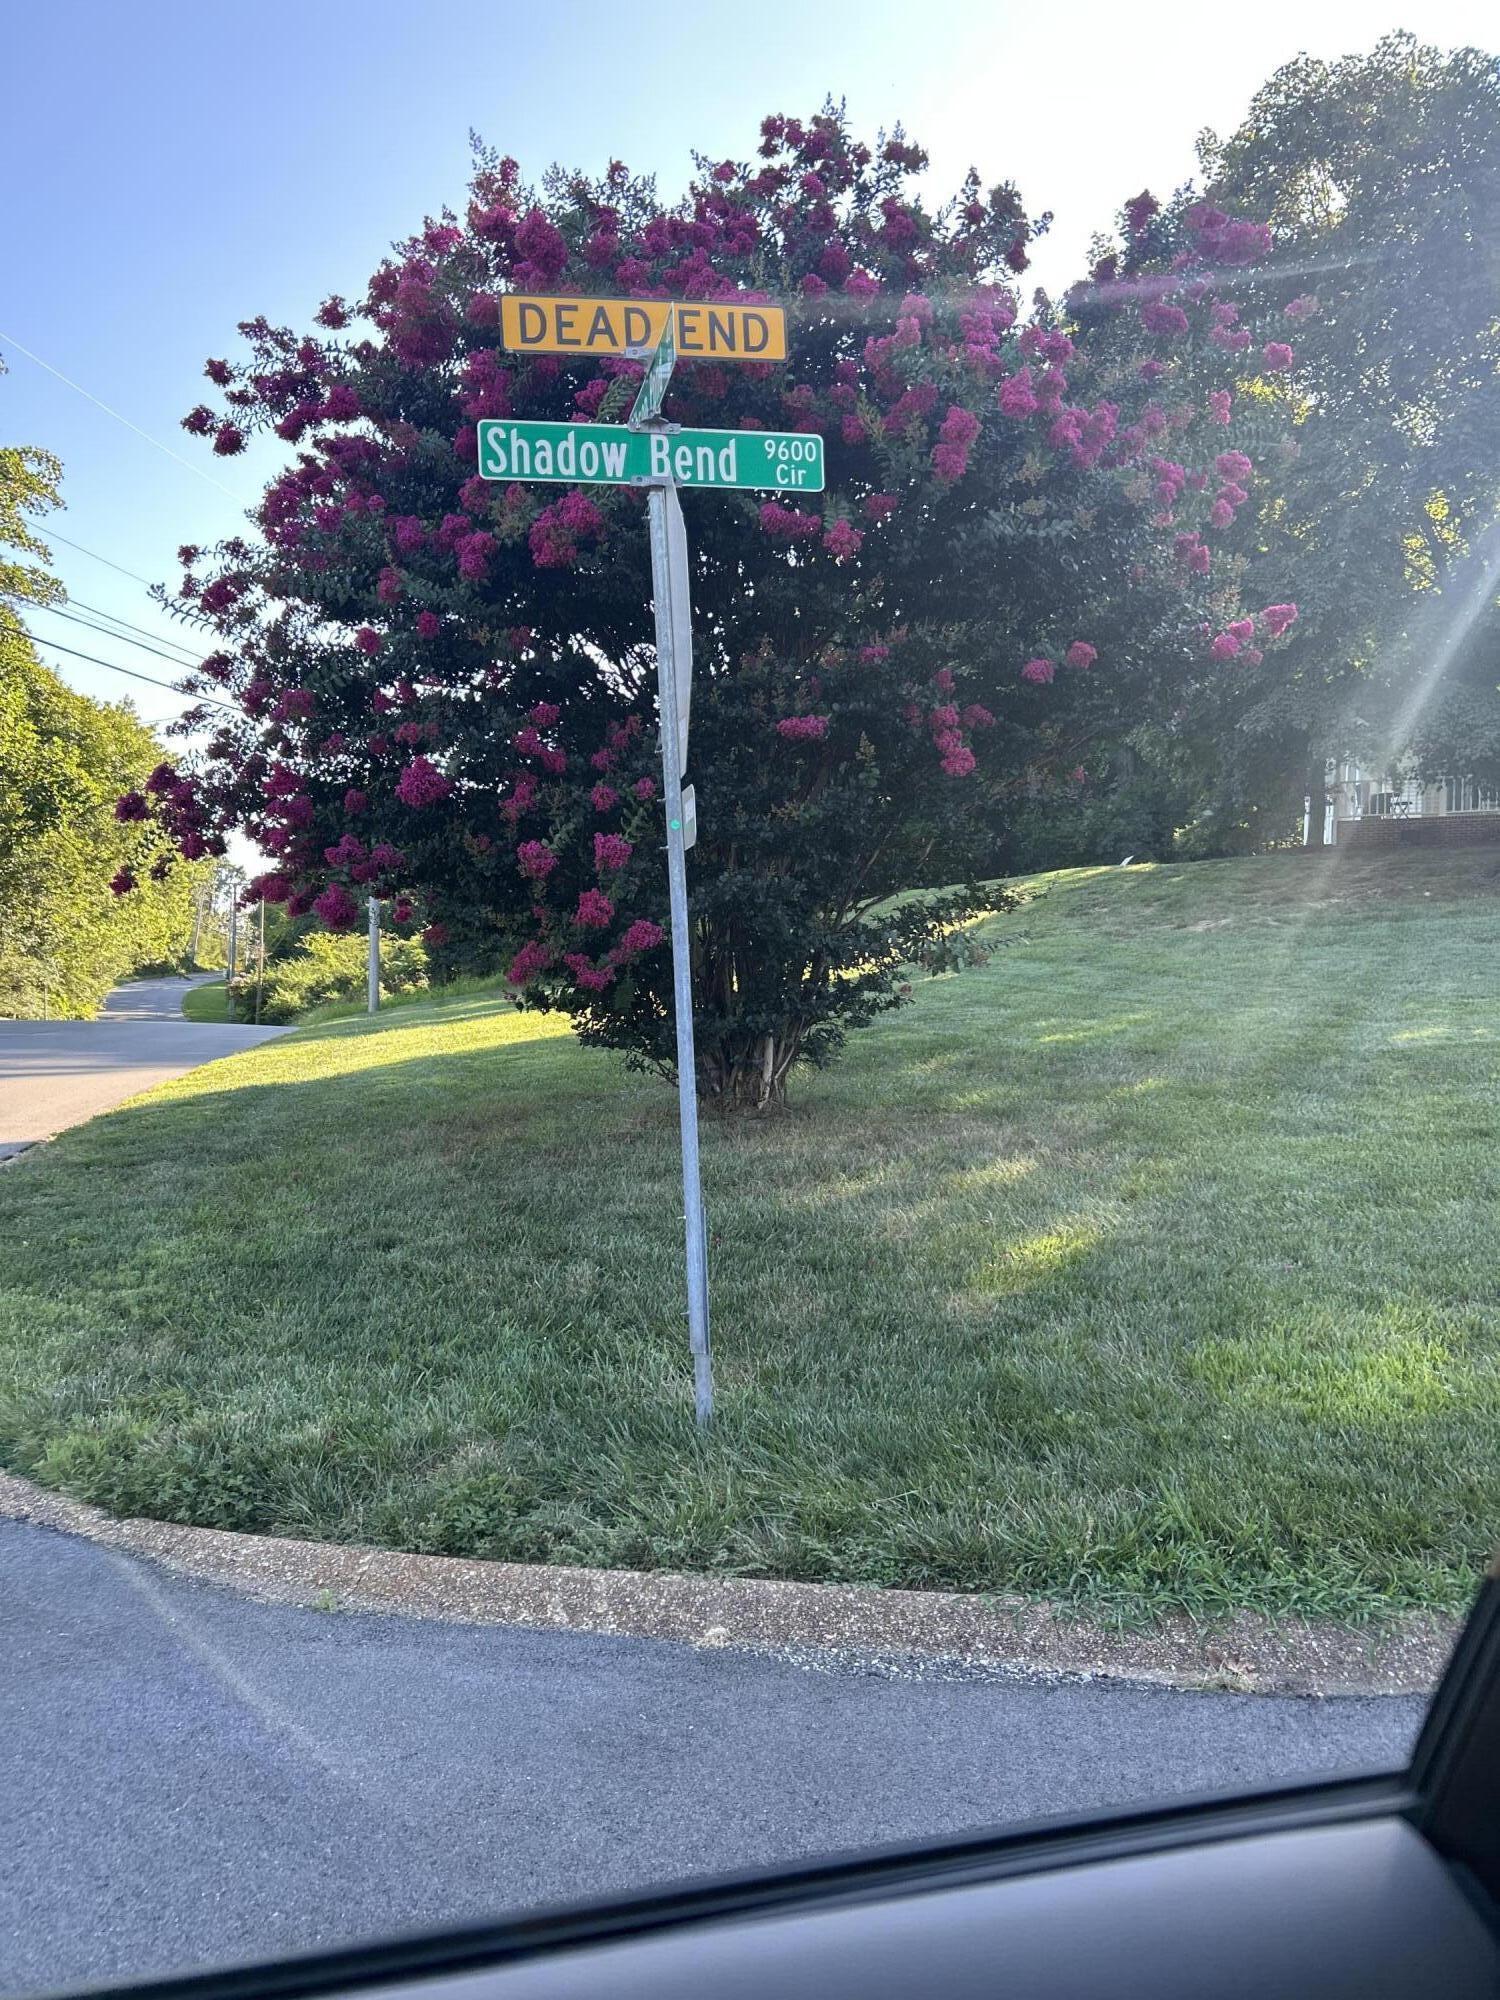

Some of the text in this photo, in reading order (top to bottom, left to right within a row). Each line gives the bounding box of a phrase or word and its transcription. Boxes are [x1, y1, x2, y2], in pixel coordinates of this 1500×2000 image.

[518, 303, 769, 353] DEAD END
[486, 426, 737, 482] Shadow Bend
[764, 439, 817, 462] 9600
[776, 464, 807, 485] Cir
